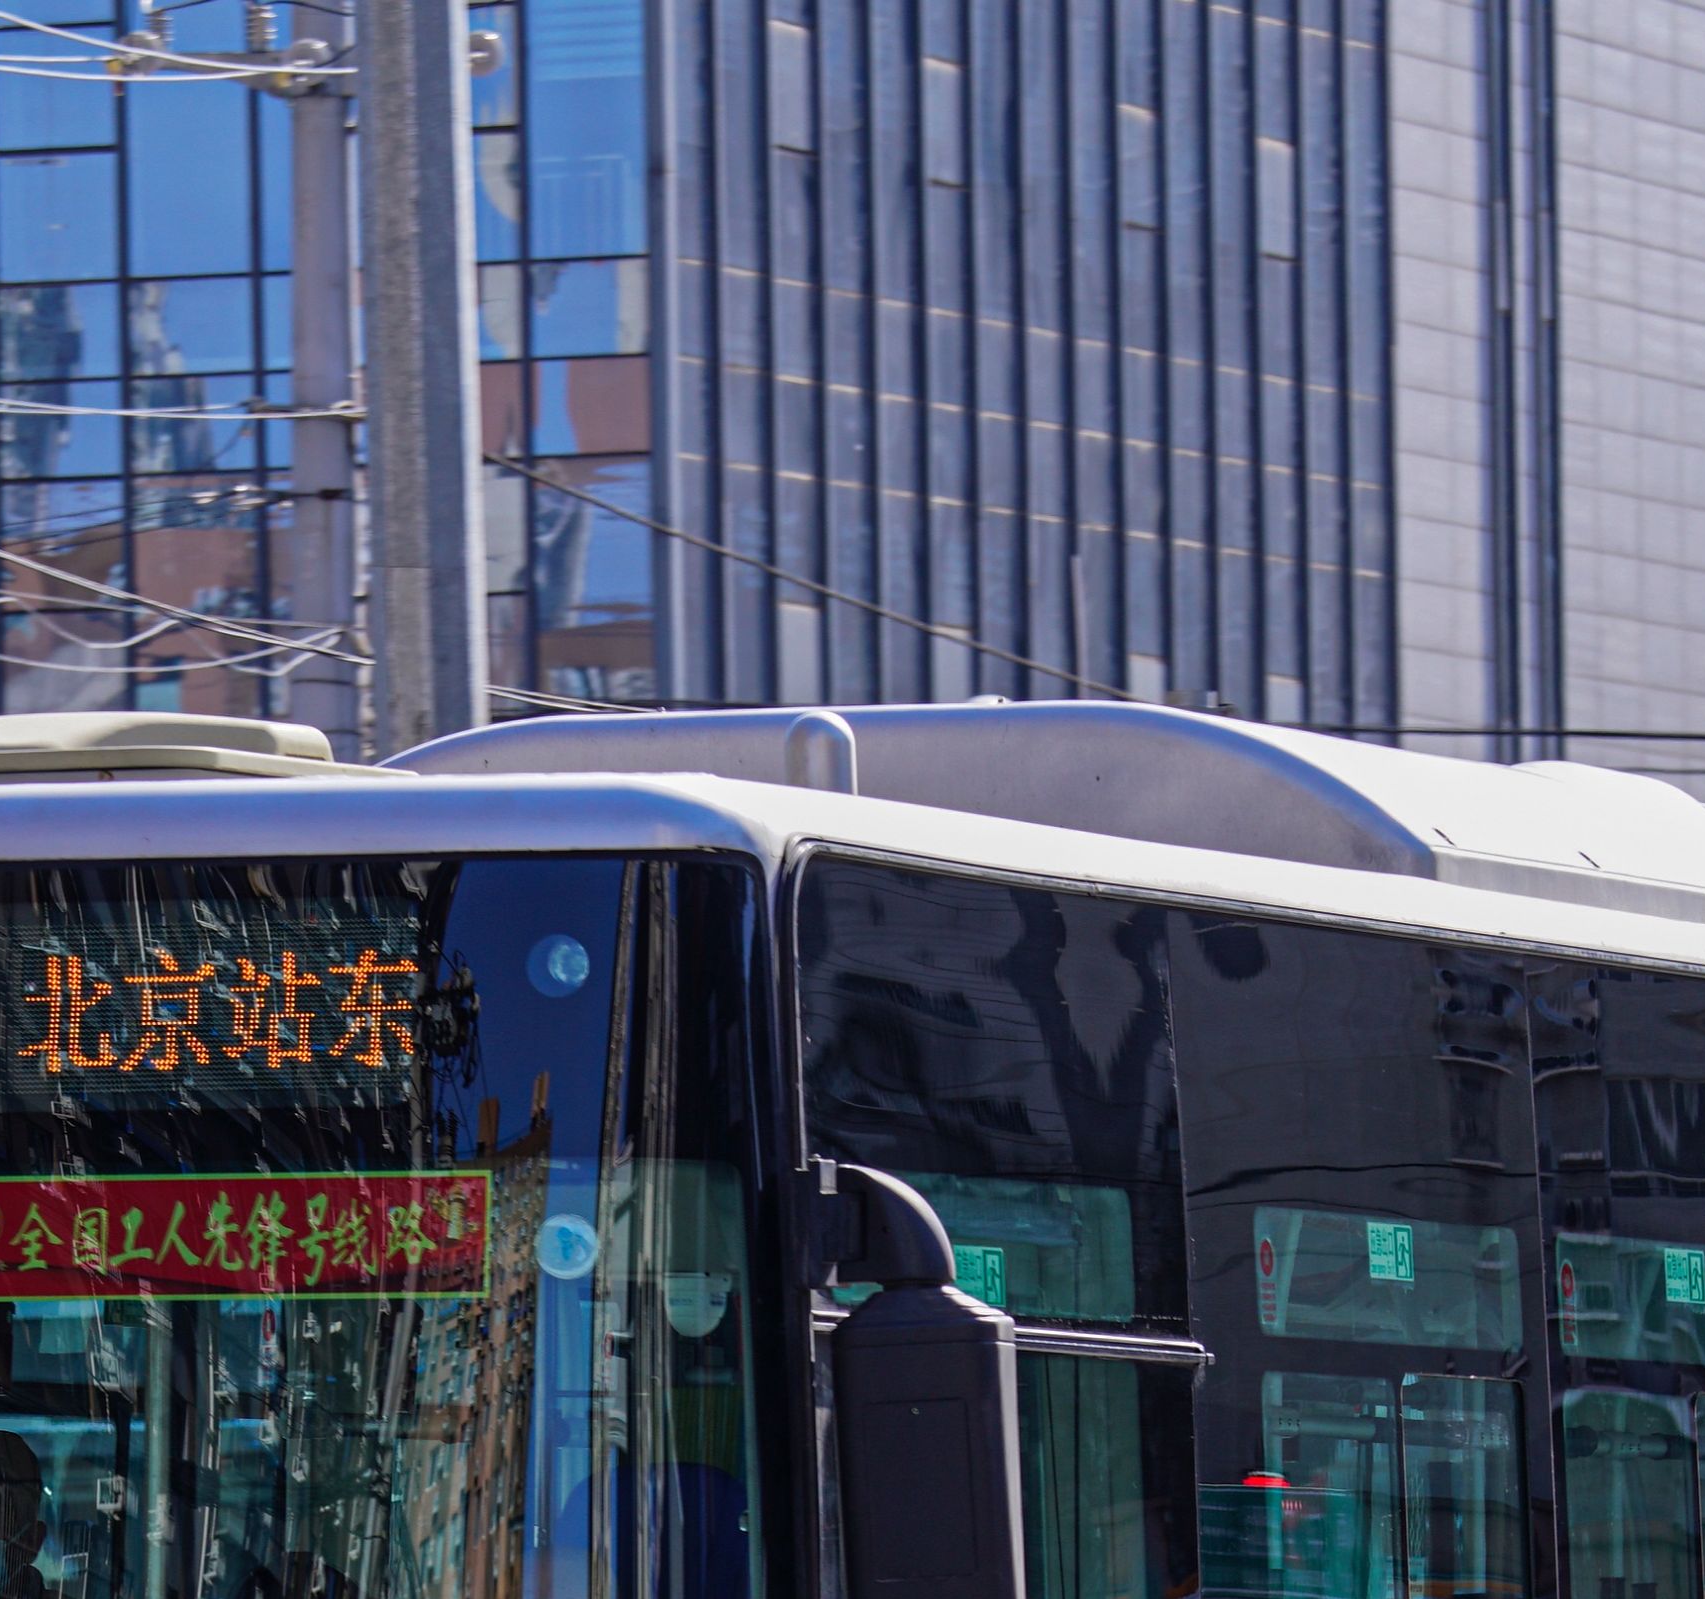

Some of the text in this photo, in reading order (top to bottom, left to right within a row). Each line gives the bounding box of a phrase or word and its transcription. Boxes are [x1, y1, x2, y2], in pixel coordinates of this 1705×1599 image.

[17, 948, 420, 1073] 北京站东
[9, 1190, 438, 1287] 全国工人先锋号线路
